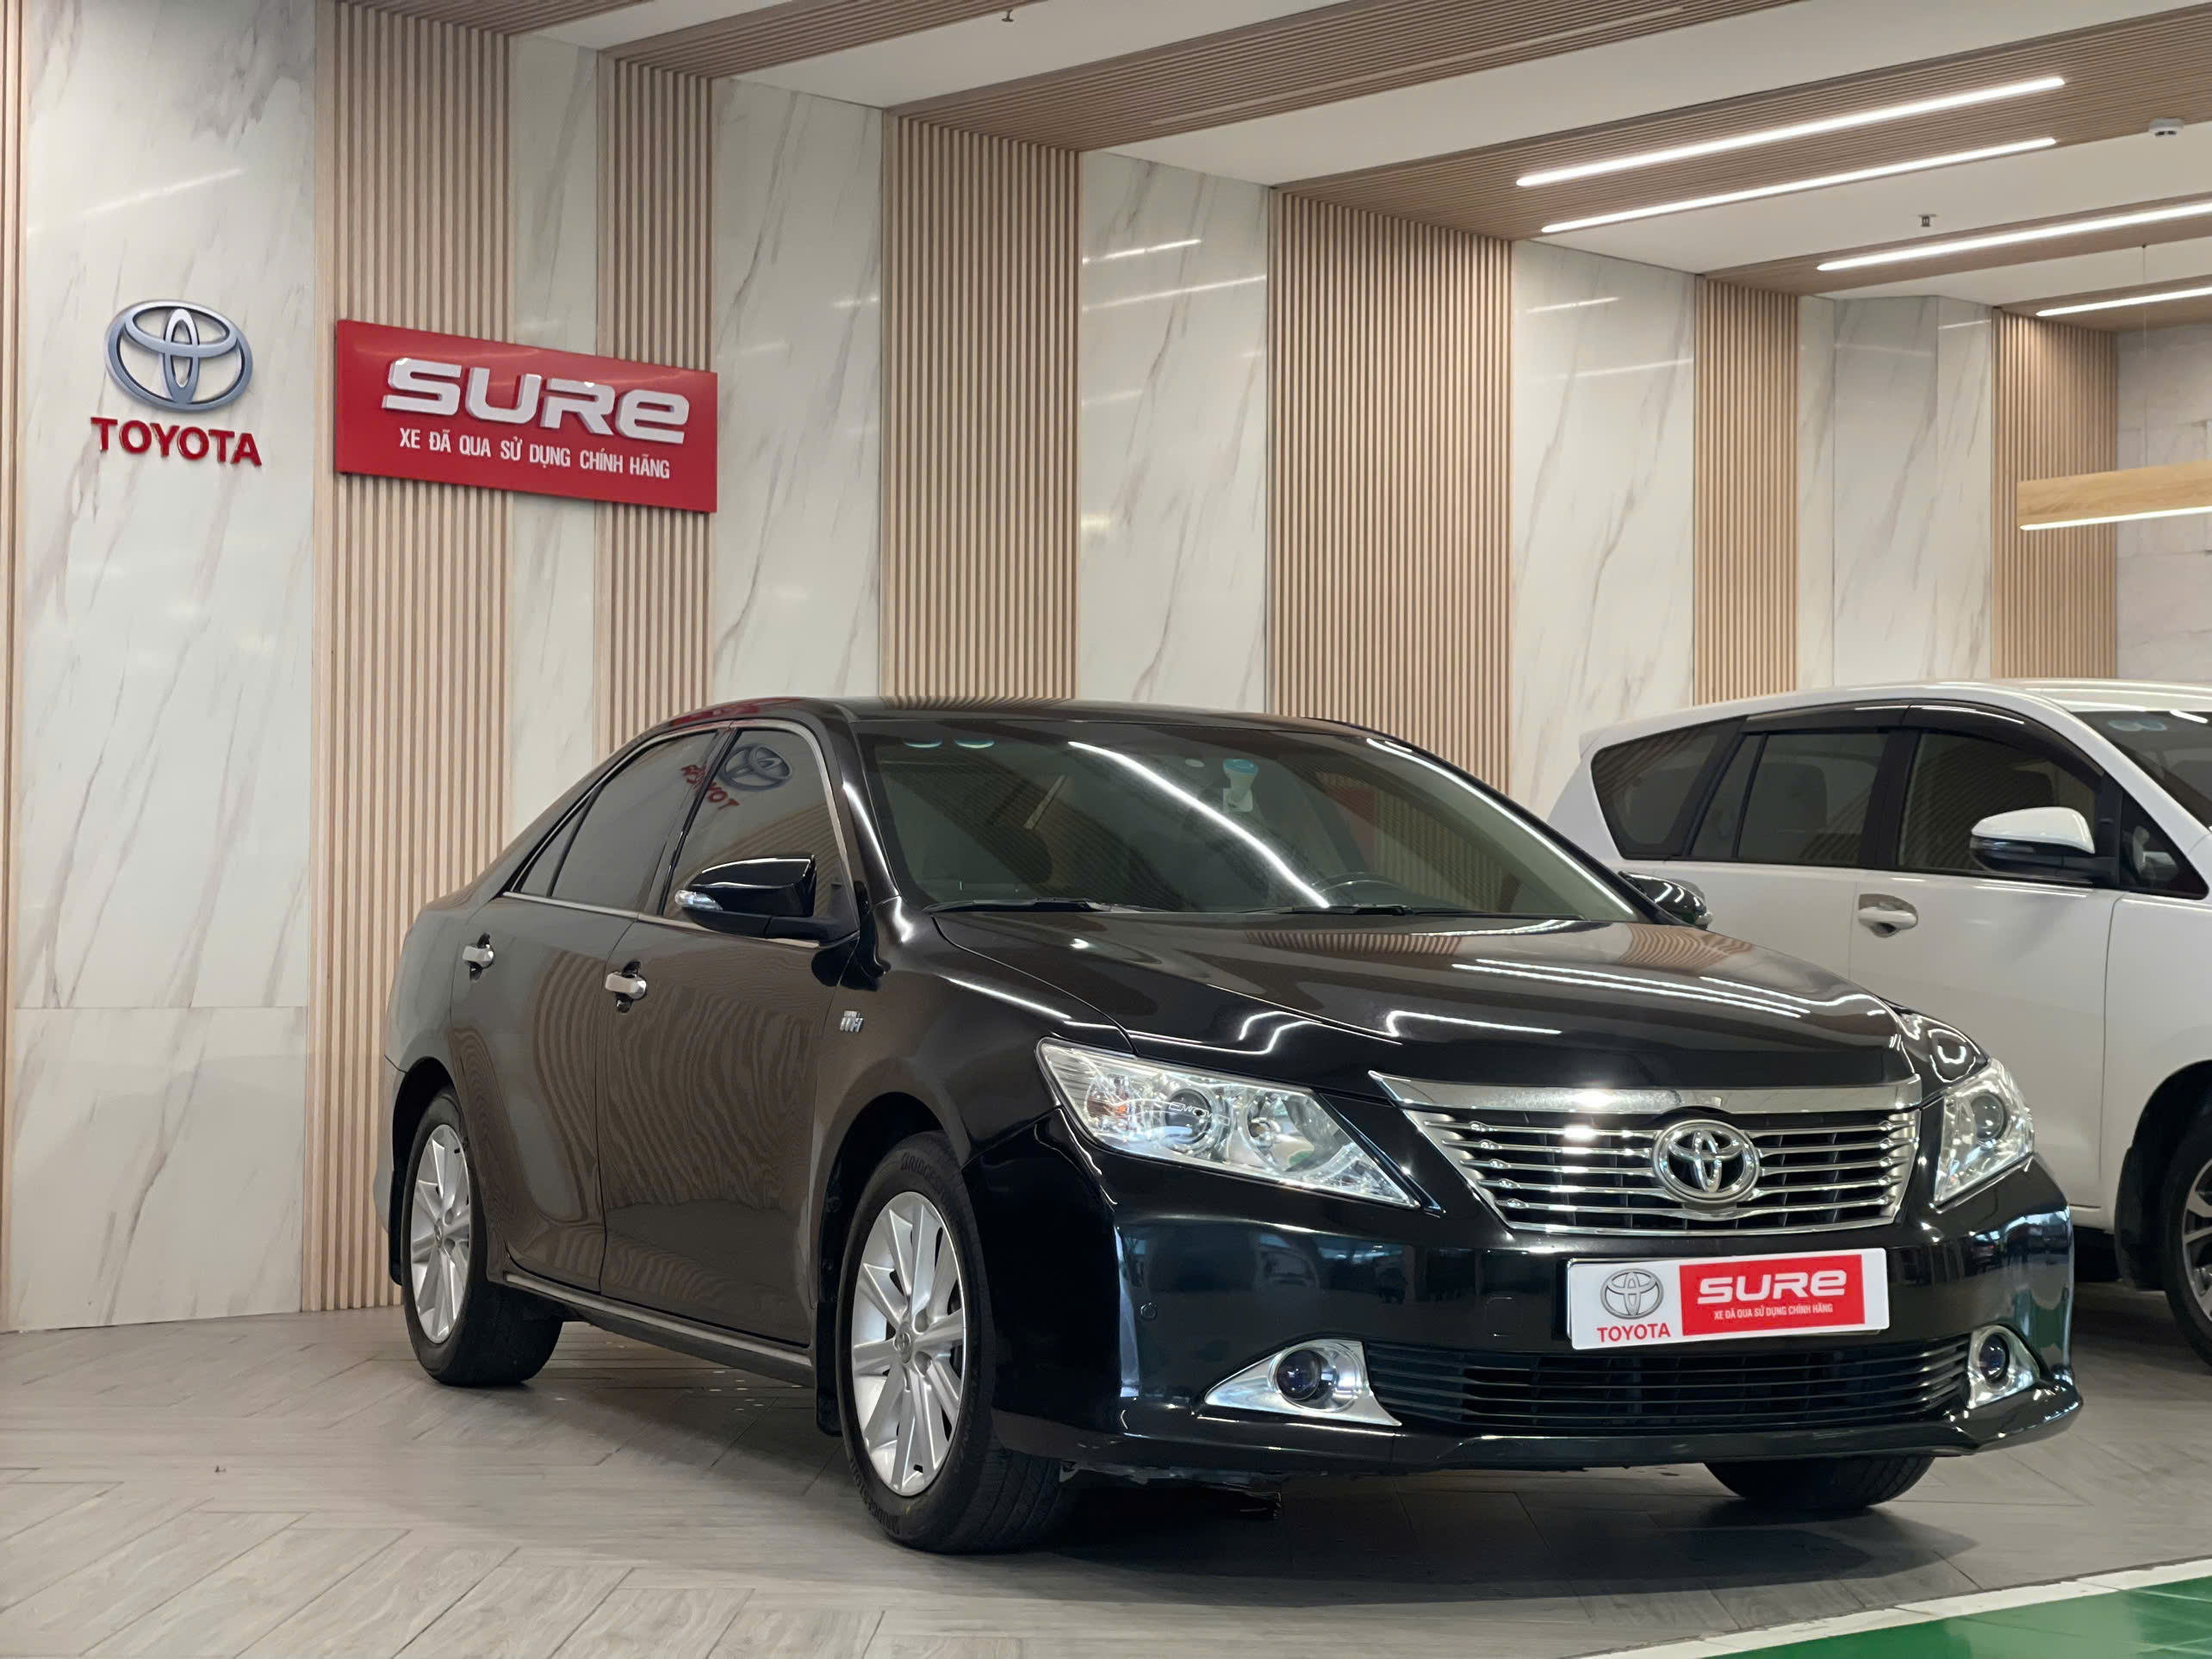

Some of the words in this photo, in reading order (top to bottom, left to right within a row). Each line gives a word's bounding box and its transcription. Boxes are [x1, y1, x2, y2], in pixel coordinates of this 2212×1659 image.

[90, 417, 262, 467] TOYOTA
[400, 427, 420, 449] XE
[429, 429, 451, 453] ĐÃ
[459, 435, 492, 457] QUA
[500, 437, 523, 461] SỬ
[529, 444, 571, 469] DỤNG
[579, 448, 624, 474] CHÍNH
[630, 453, 670, 479] HÃNG
[1596, 1322, 1671, 1343] TOYOTA
[1714, 1310, 1724, 1320] XE
